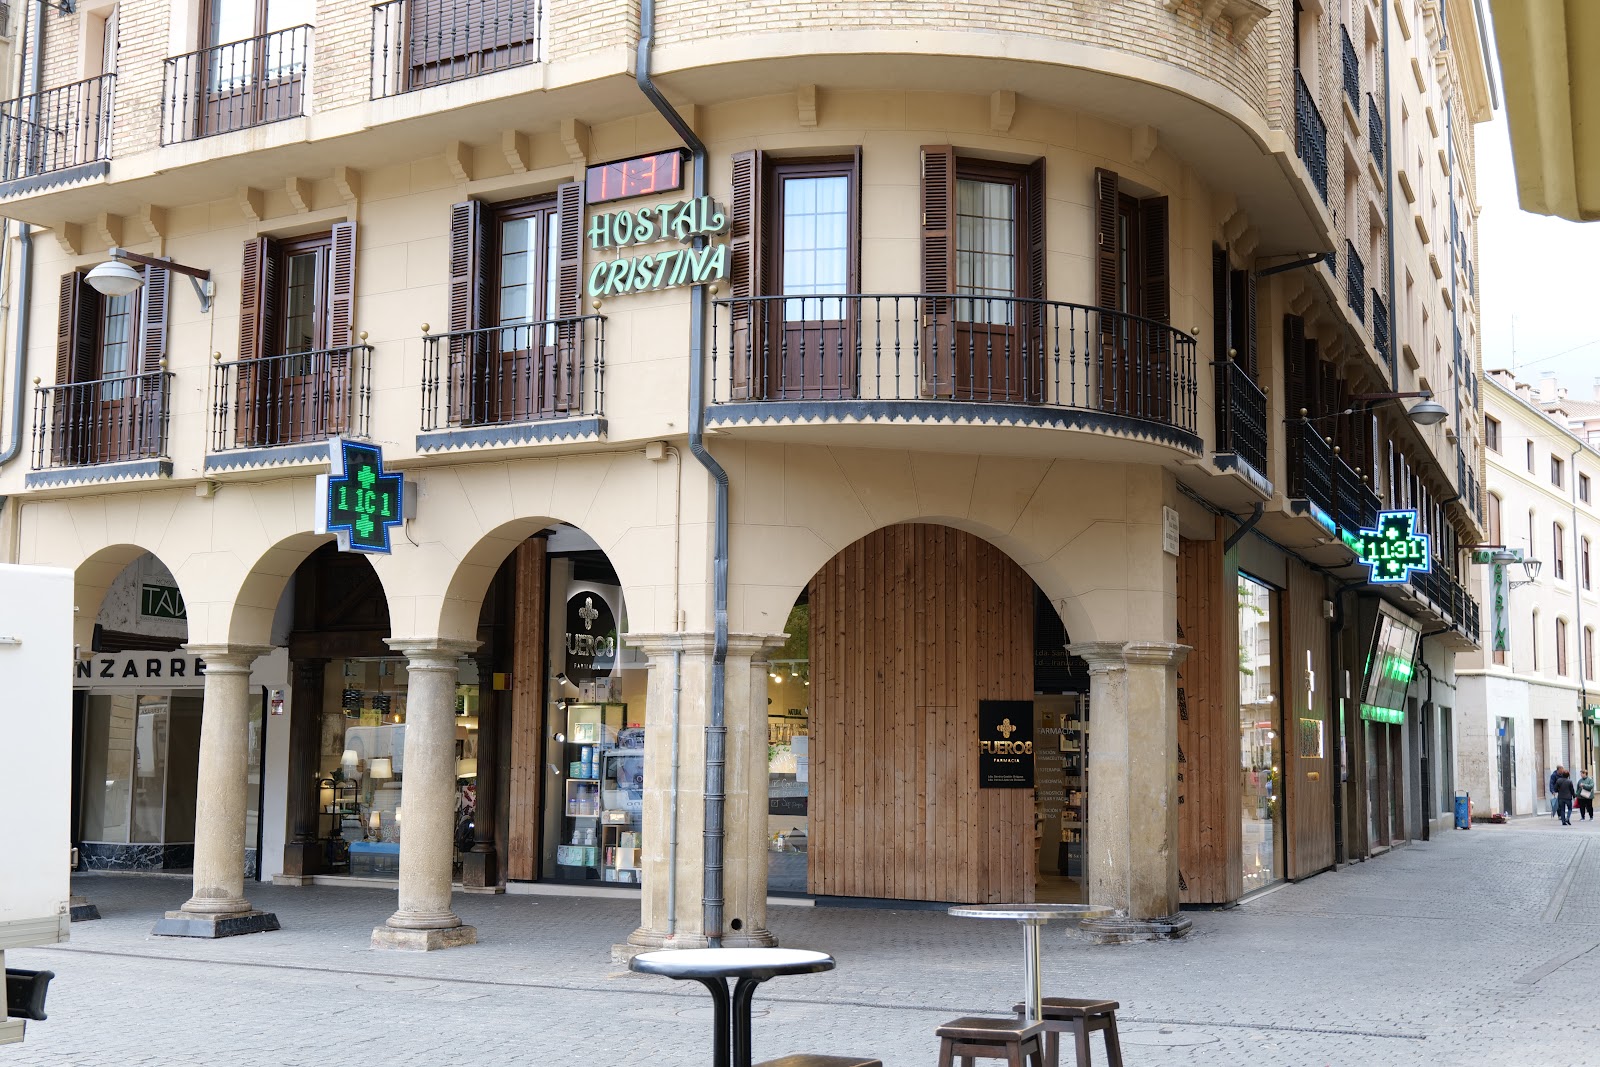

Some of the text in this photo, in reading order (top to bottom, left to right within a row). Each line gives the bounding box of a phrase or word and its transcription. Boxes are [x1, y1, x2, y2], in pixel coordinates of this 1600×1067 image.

[601, 153, 678, 199] 11:31
[587, 196, 726, 249] HOSTAL
[588, 244, 726, 297] CRISTINA
[1367, 541, 1420, 559] 11:31
[1494, 563, 1506, 650] CRISTINA
[76, 658, 207, 679] NZARRE
[1038, 727, 1075, 735] FARMACIA
